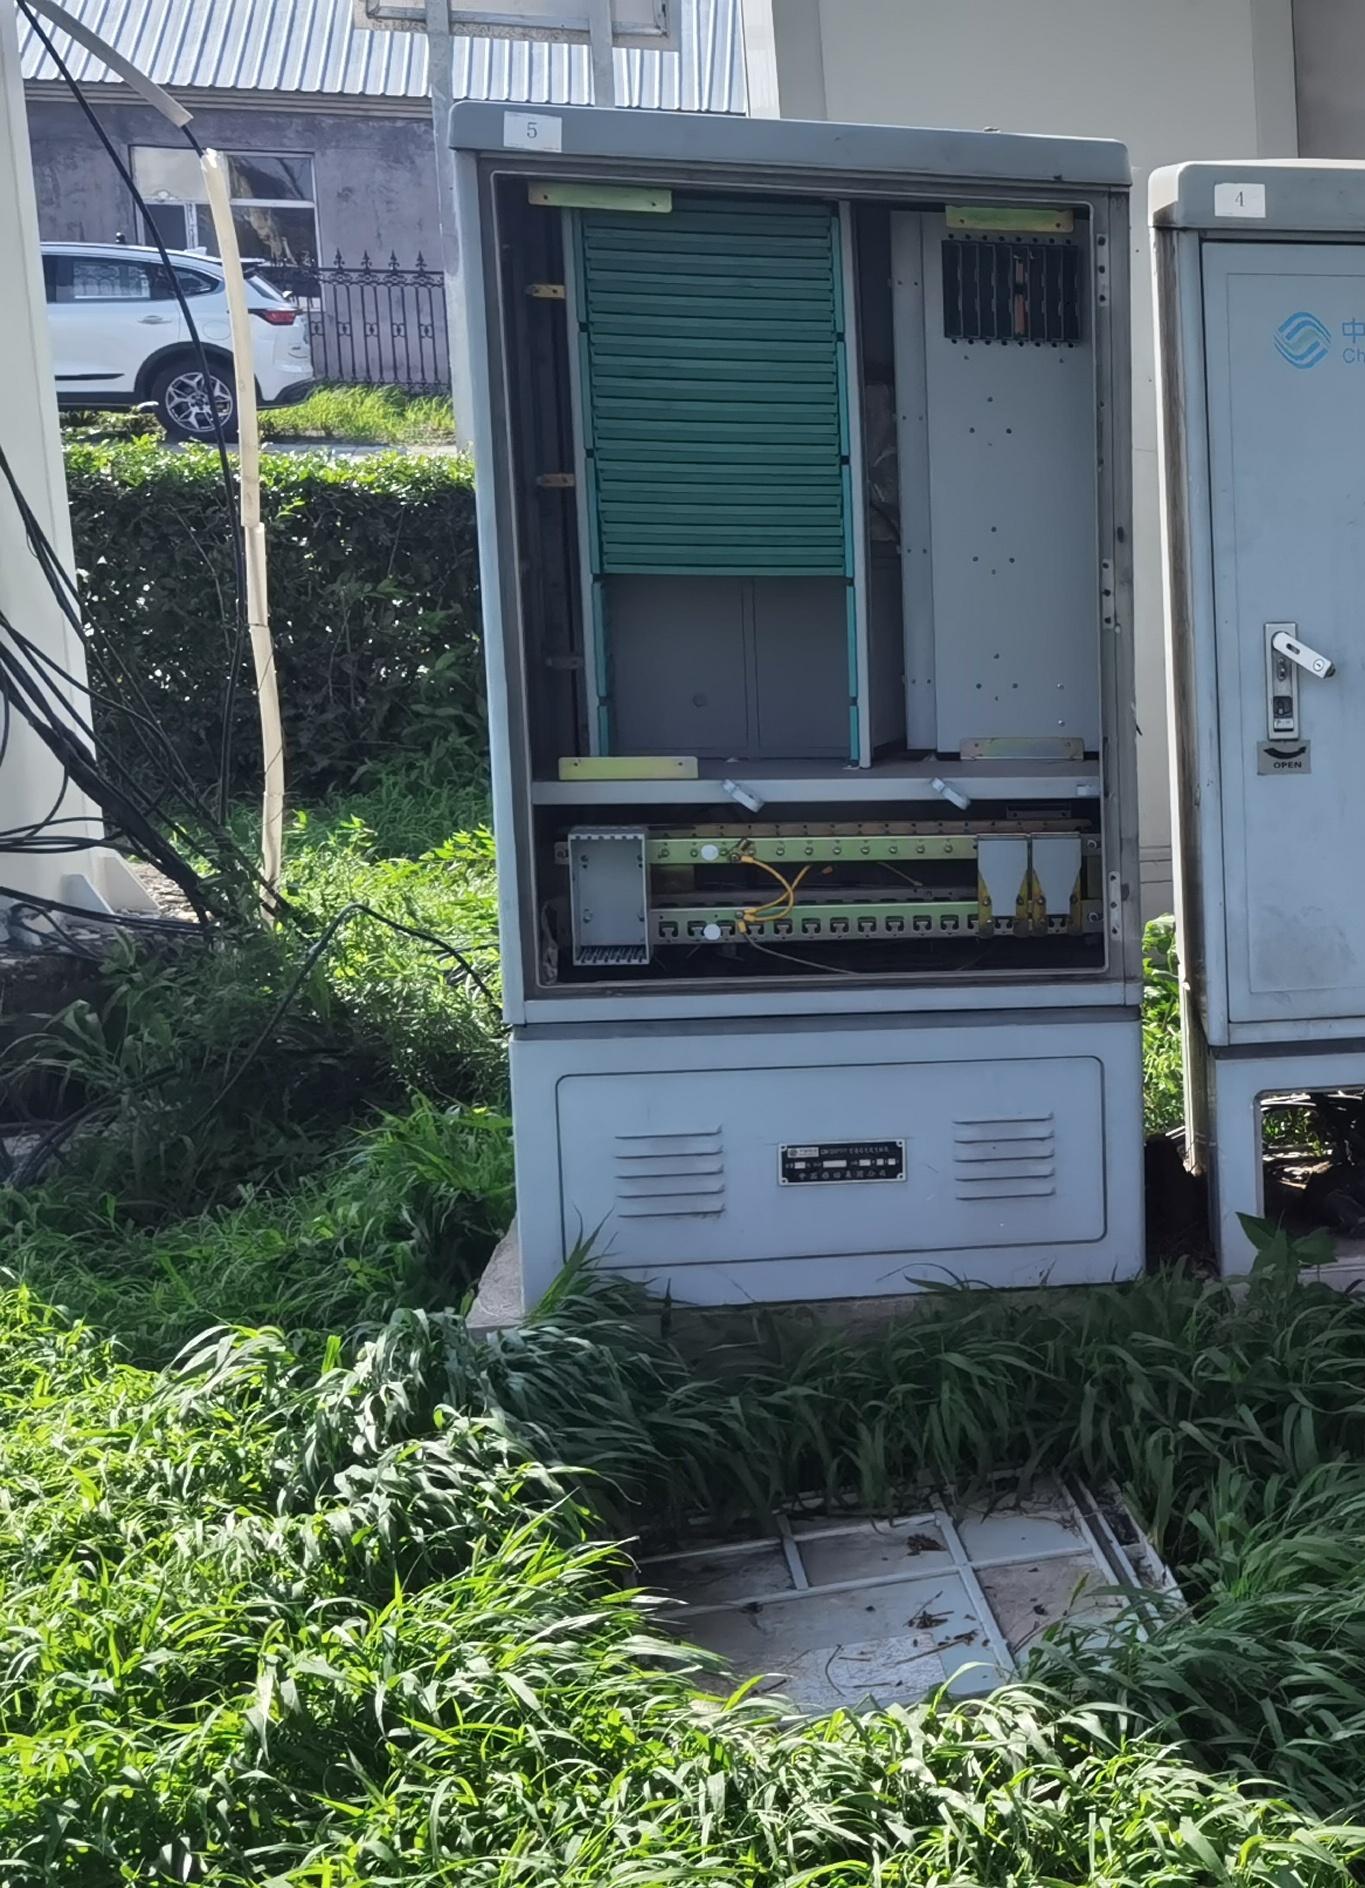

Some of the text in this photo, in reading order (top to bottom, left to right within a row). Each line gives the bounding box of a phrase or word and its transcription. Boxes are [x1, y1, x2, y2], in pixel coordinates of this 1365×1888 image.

[526, 121, 538, 139] 5
[1234, 191, 1244, 207] 4
[1272, 760, 1303, 769] OPEN
